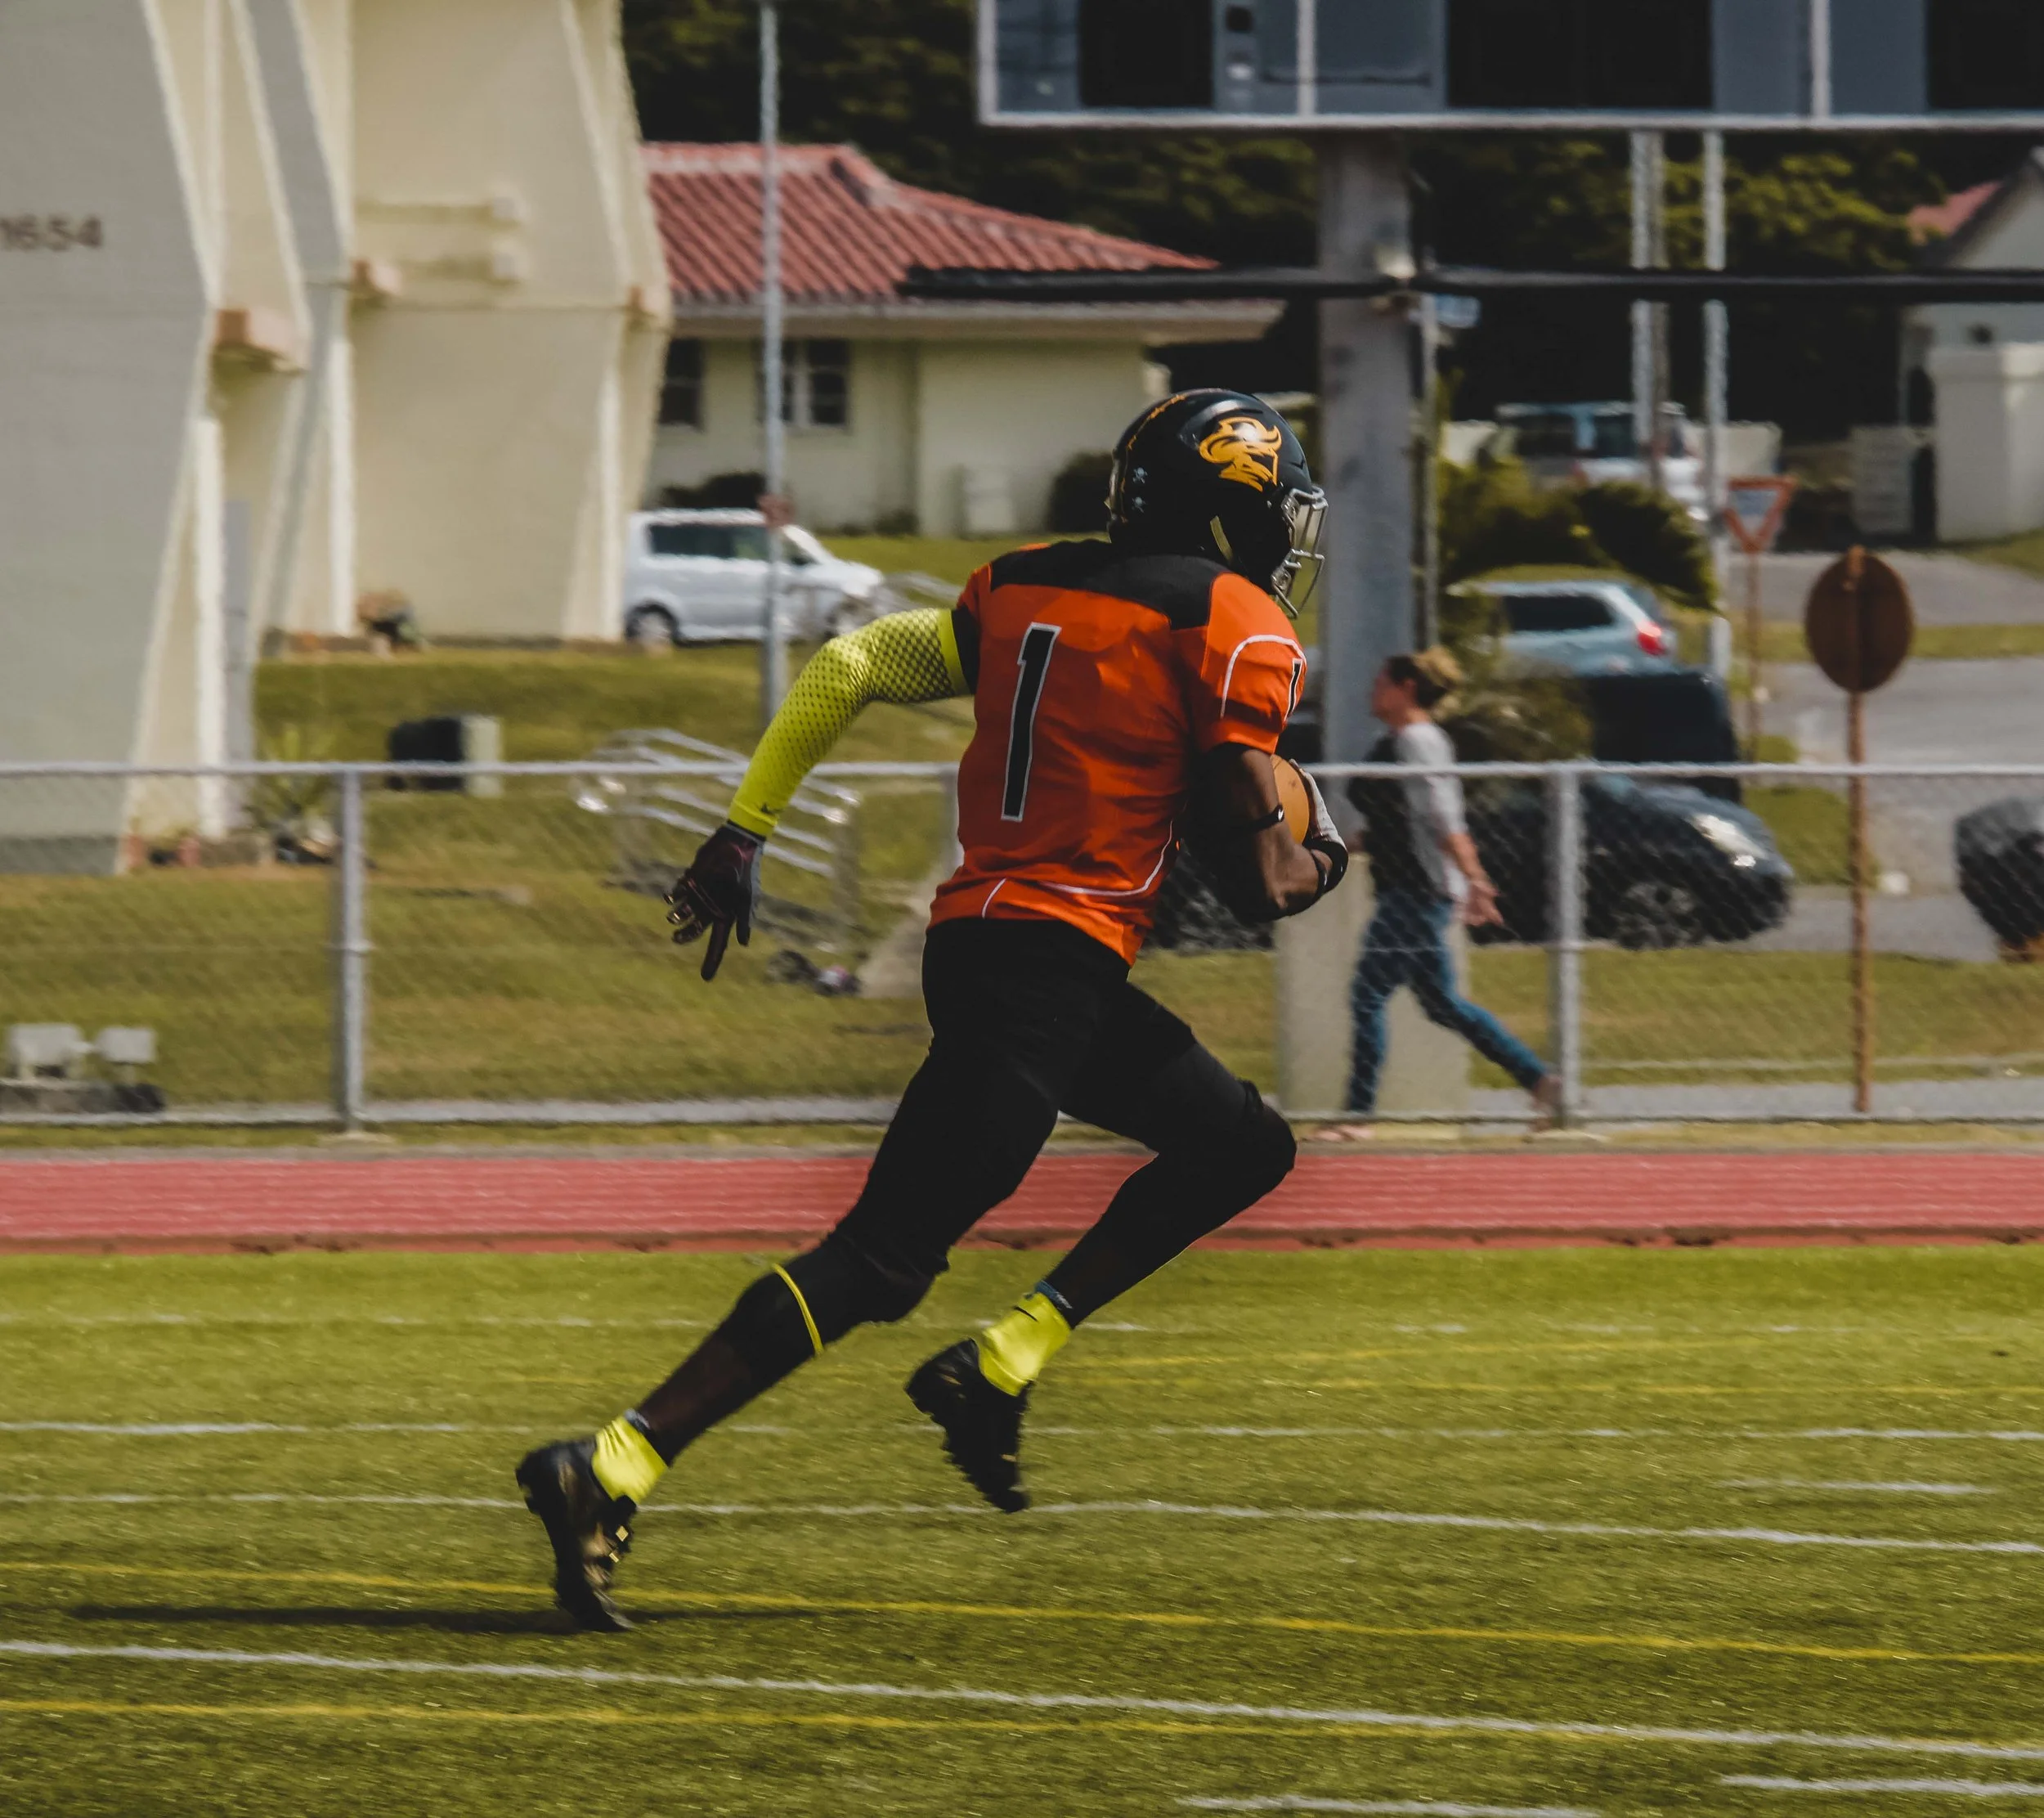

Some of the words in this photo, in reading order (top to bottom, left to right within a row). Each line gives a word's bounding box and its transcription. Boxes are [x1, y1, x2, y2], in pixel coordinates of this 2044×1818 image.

[0, 214, 102, 252] 1654
[1284, 658, 1303, 721] 1
[1001, 622, 1061, 822] 1
